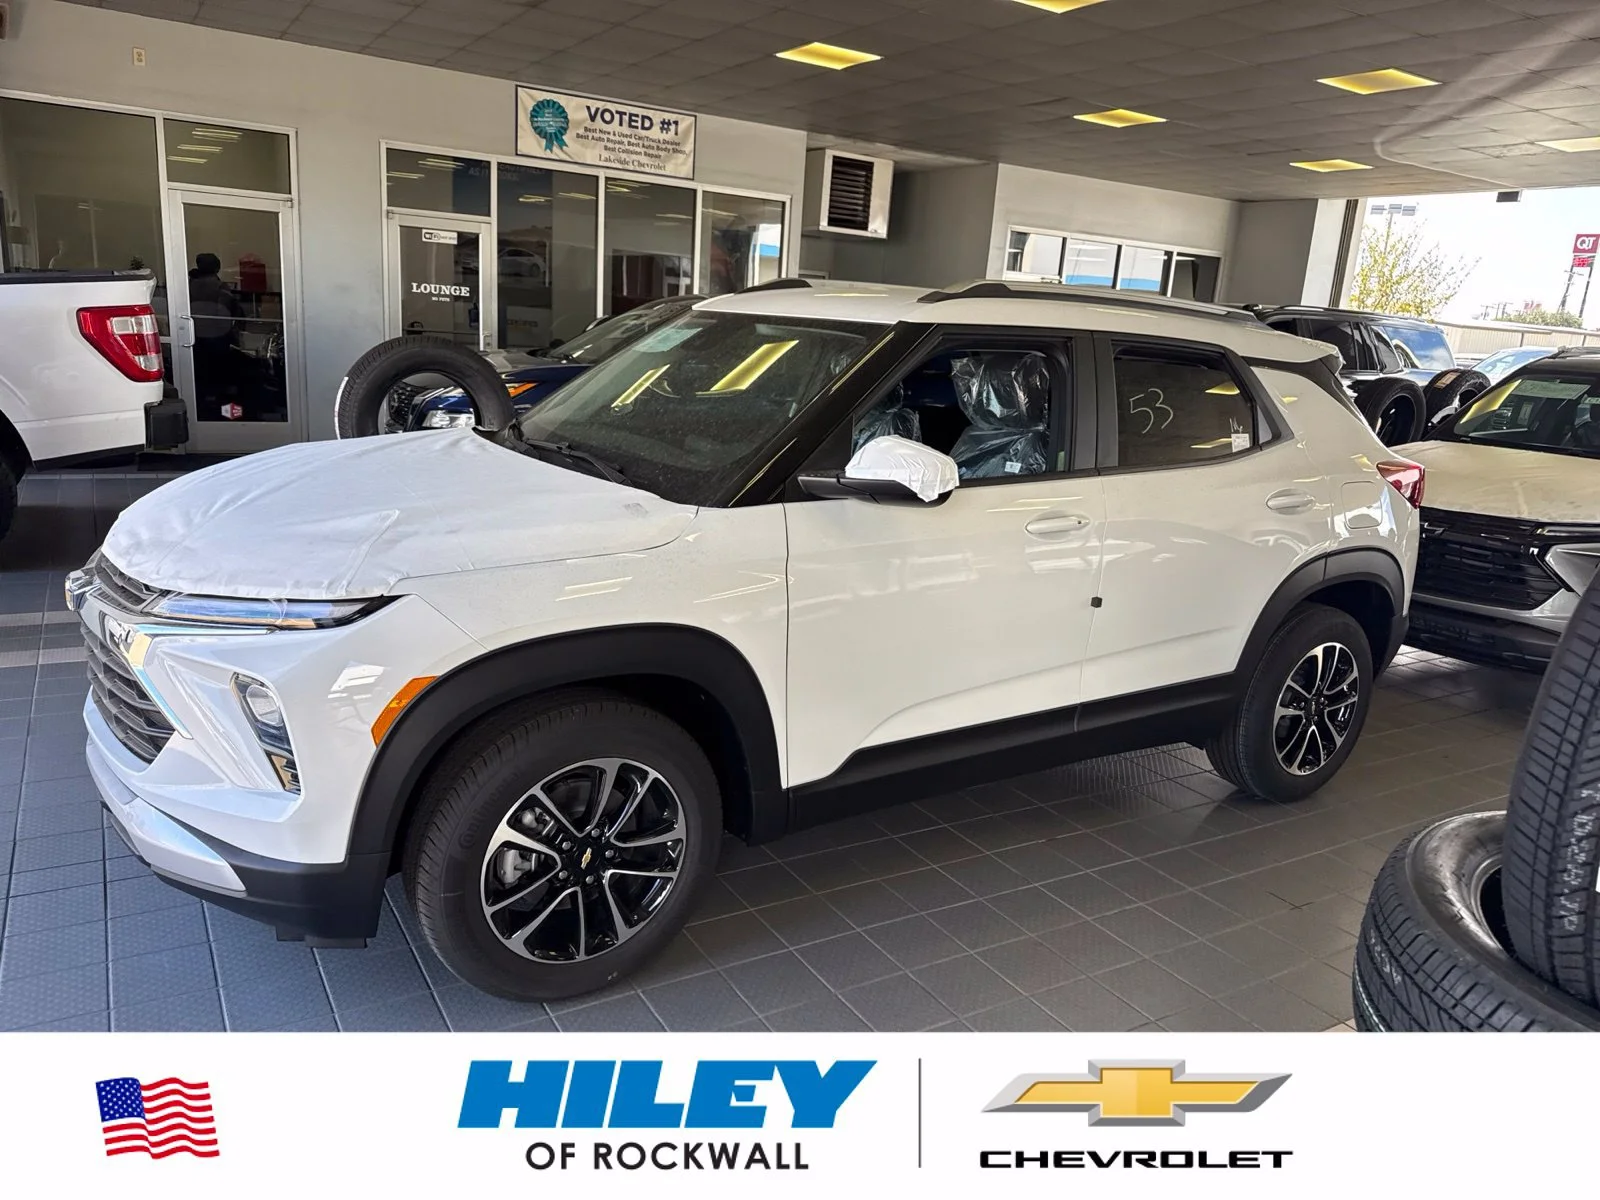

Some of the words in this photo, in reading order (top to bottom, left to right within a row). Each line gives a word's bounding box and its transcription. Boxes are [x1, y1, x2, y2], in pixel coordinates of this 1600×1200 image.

[585, 105, 654, 131] VOTED
[659, 118, 679, 136] #1
[575, 132, 590, 141] Best
[590, 134, 605, 142] Auto
[606, 137, 626, 146] Repair,
[627, 140, 640, 148] Best
[641, 143, 655, 151] Auto
[656, 145, 671, 154] Body
[583, 126, 598, 134] Best
[598, 128, 611, 136] New
[617, 131, 632, 139] Used
[633, 133, 661, 145] Car/Truck
[662, 138, 681, 147] Dealer
[603, 144, 617, 152] Best
[617, 147, 642, 156] Collision
[643, 151, 661, 159] Repair
[598, 153, 630, 166] Lakeside
[631, 160, 666, 171] Chevrolet
[1576, 236, 1597, 250] QT
[411, 282, 470, 297] LOUNGE
[1129, 388, 1174, 434] 53
